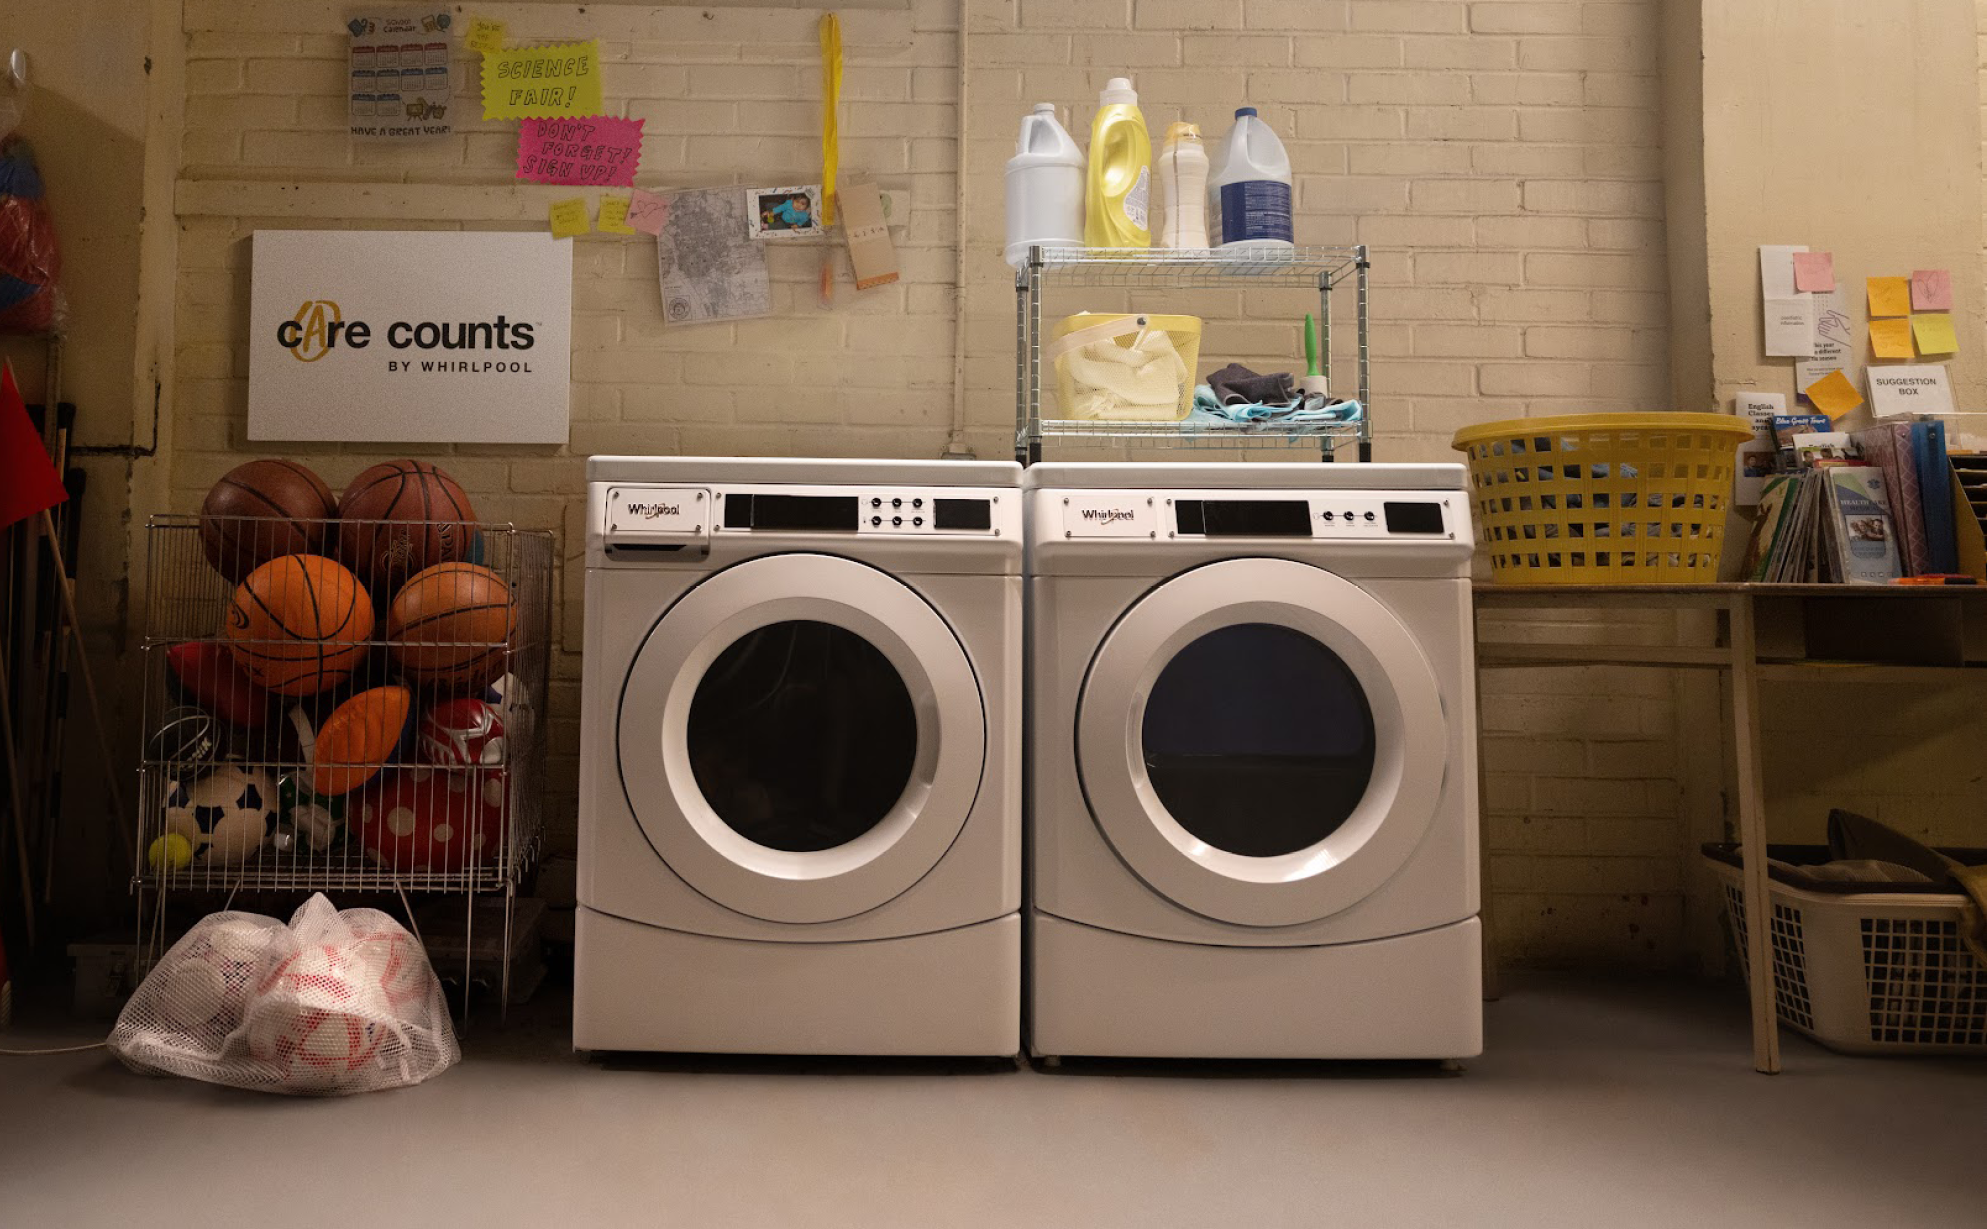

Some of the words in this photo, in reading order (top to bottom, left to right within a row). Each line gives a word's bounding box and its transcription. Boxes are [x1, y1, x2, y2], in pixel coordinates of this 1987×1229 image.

[497, 55, 589, 79] SCIENCE
[509, 86, 577, 108] FAIR!
[350, 126, 377, 136] HAVE
[379, 127, 387, 136] A
[388, 126, 422, 137] GREAT
[422, 125, 452, 135] YEAR!
[537, 121, 596, 142] DON'T
[541, 141, 633, 166] FORGET!
[523, 154, 575, 178] SIGN
[579, 164, 618, 182] UP!
[388, 361, 411, 372] BY
[421, 361, 533, 373] WHIRLPOOL
[1876, 377, 1937, 386] SUGGESTION
[1898, 387, 1919, 395] BOX
[1748, 403, 1774, 411] English
[628, 503, 680, 517] Whirlpool
[1081, 509, 1134, 521] Whirlpool
